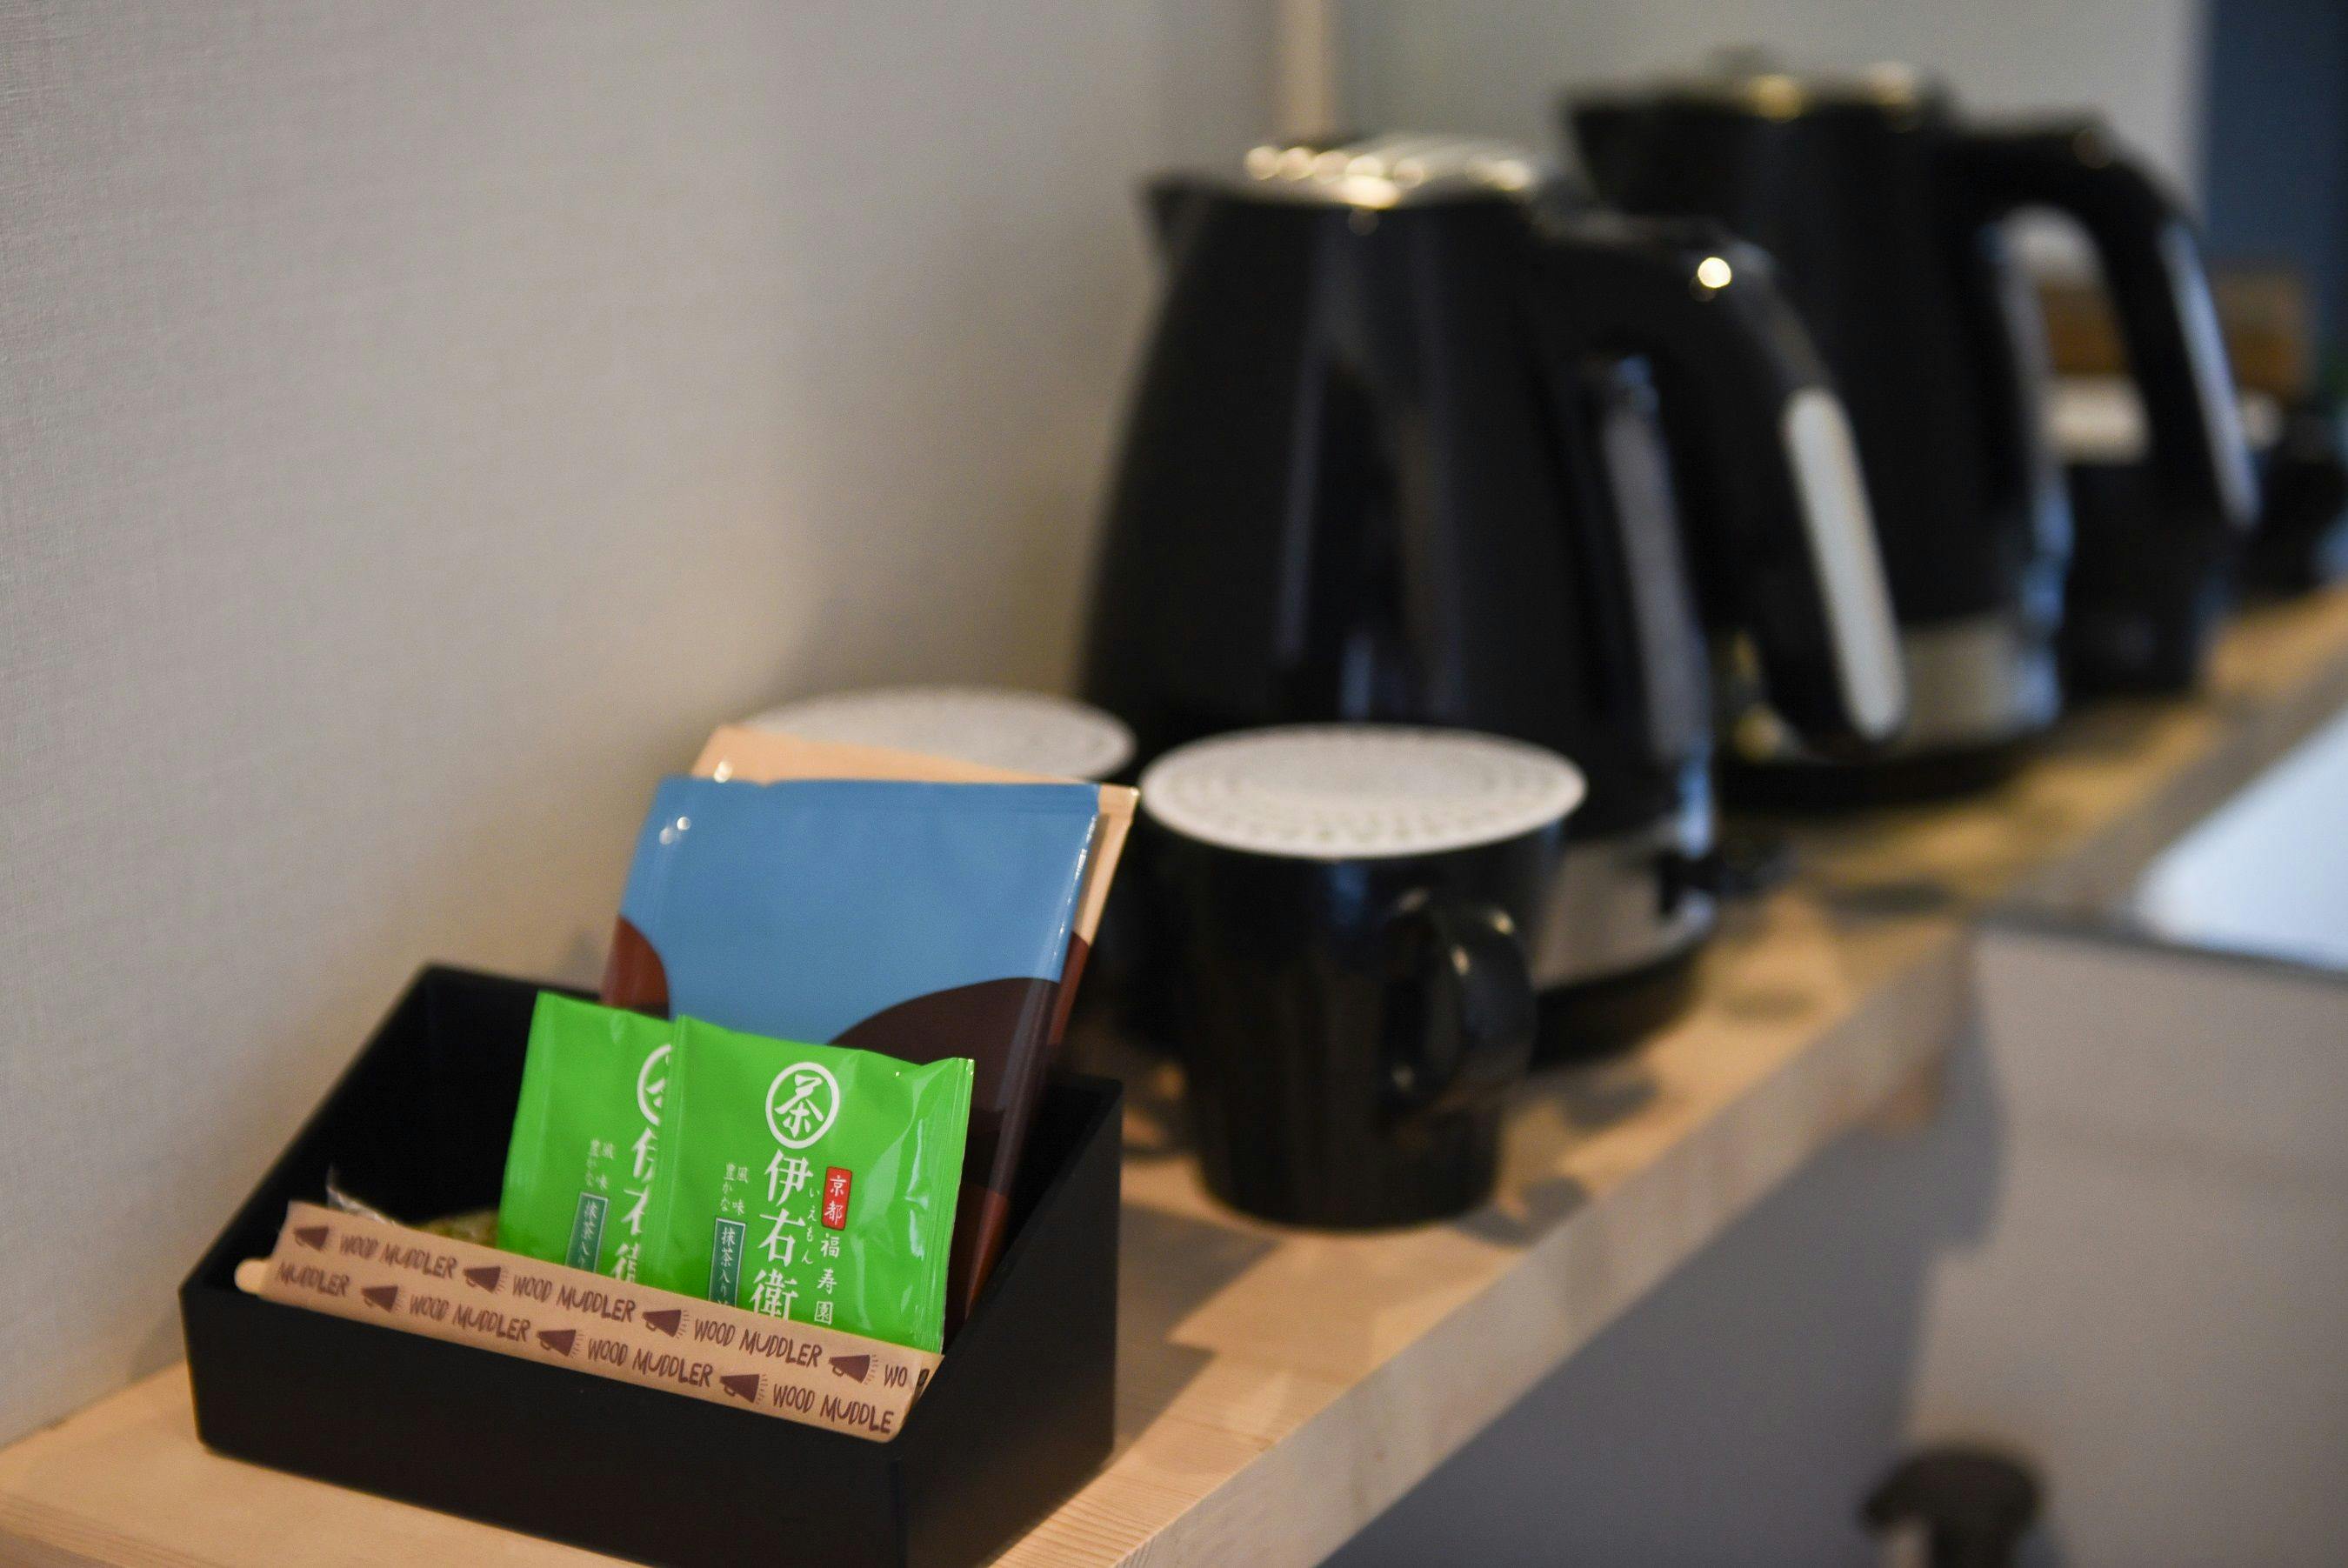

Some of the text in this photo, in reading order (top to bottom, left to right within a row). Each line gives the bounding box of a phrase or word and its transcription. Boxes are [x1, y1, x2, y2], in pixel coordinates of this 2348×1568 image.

[772, 1072, 825, 1139] 茶
[717, 1226, 736, 1306] 抹茶入り
[801, 1187, 820, 1265] いえもん
[814, 1175, 847, 1325] 京都 福寿園
[277, 1261, 350, 1298] MUDDLER
[410, 1294, 450, 1321] WOOD
[452, 1304, 531, 1343] MUDDLER
[587, 1338, 629, 1367] WOOD
[632, 1348, 713, 1387] MUDDLER
[772, 1384, 816, 1413] WOOD
[339, 1233, 379, 1260] WOOD
[380, 1242, 457, 1279] MUDDLER
[512, 1274, 552, 1303] WOOD
[556, 1284, 636, 1322] MUDDLER
[694, 1318, 736, 1347] WOOD
[739, 1329, 823, 1368] MUDDLER
